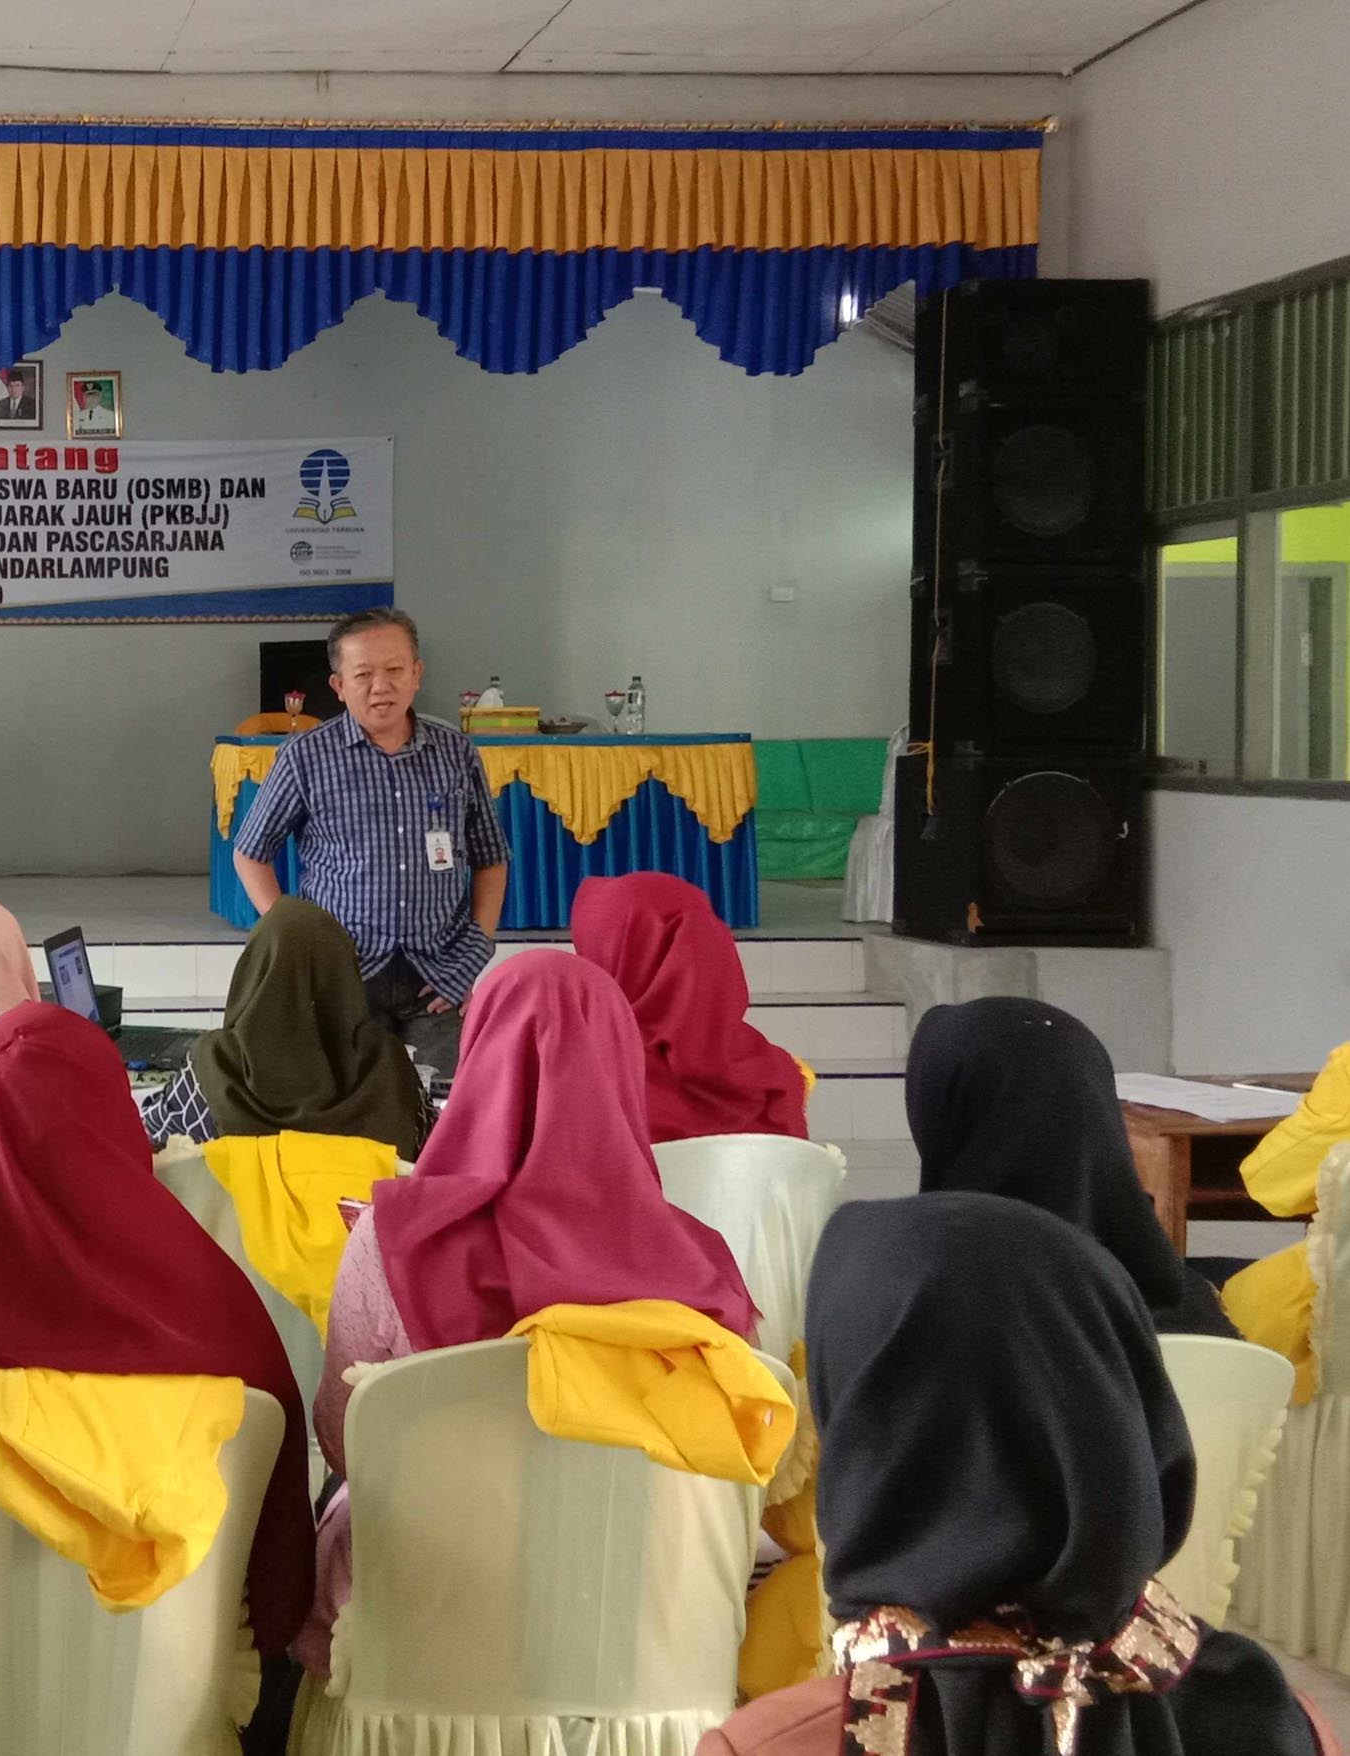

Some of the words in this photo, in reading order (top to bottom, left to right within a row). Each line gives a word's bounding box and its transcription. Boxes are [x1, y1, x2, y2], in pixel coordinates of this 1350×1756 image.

[56, 479, 119, 502] BARU
[127, 478, 211, 505] (OSMB)
[220, 478, 267, 501] DAN
[72, 505, 134, 527] JAUH
[142, 504, 230, 531] (PKBJJ)
[47, 531, 225, 552] PASCASARJANA
